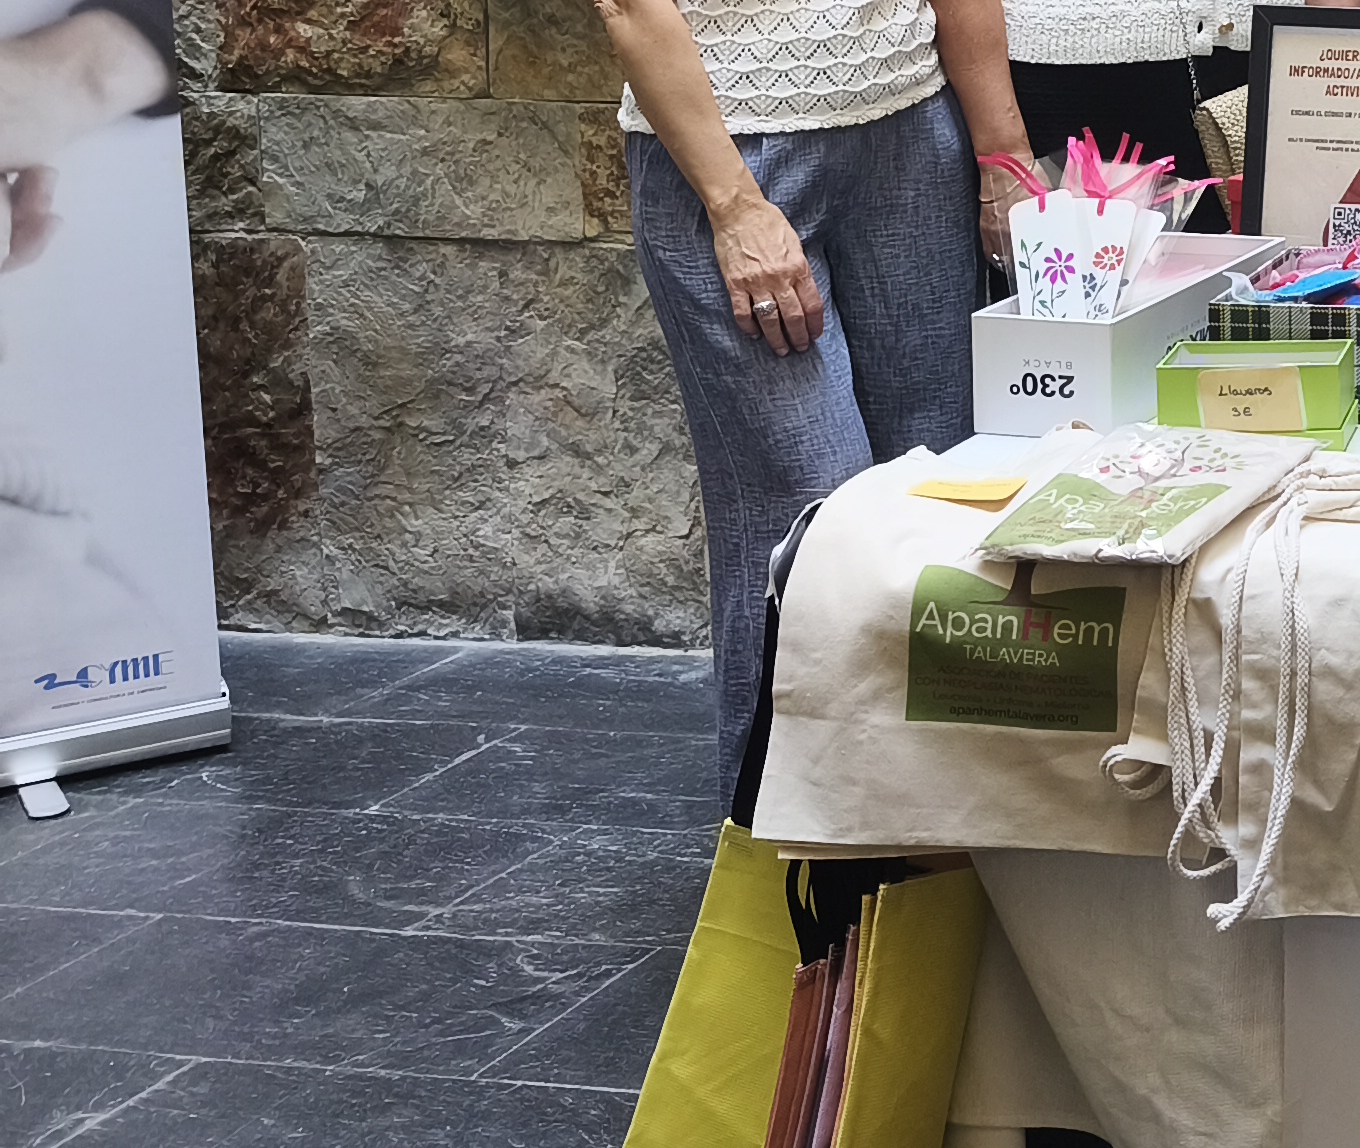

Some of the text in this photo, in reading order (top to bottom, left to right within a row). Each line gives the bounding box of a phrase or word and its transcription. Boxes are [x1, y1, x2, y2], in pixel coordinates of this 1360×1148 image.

[1022, 359, 1073, 370] BLACK
[1218, 384, 1273, 397] Llaveros
[915, 601, 1114, 647] ApanHem
[962, 644, 1060, 667] TALAVERA
[950, 704, 1079, 725] apanhemtalavera.org
